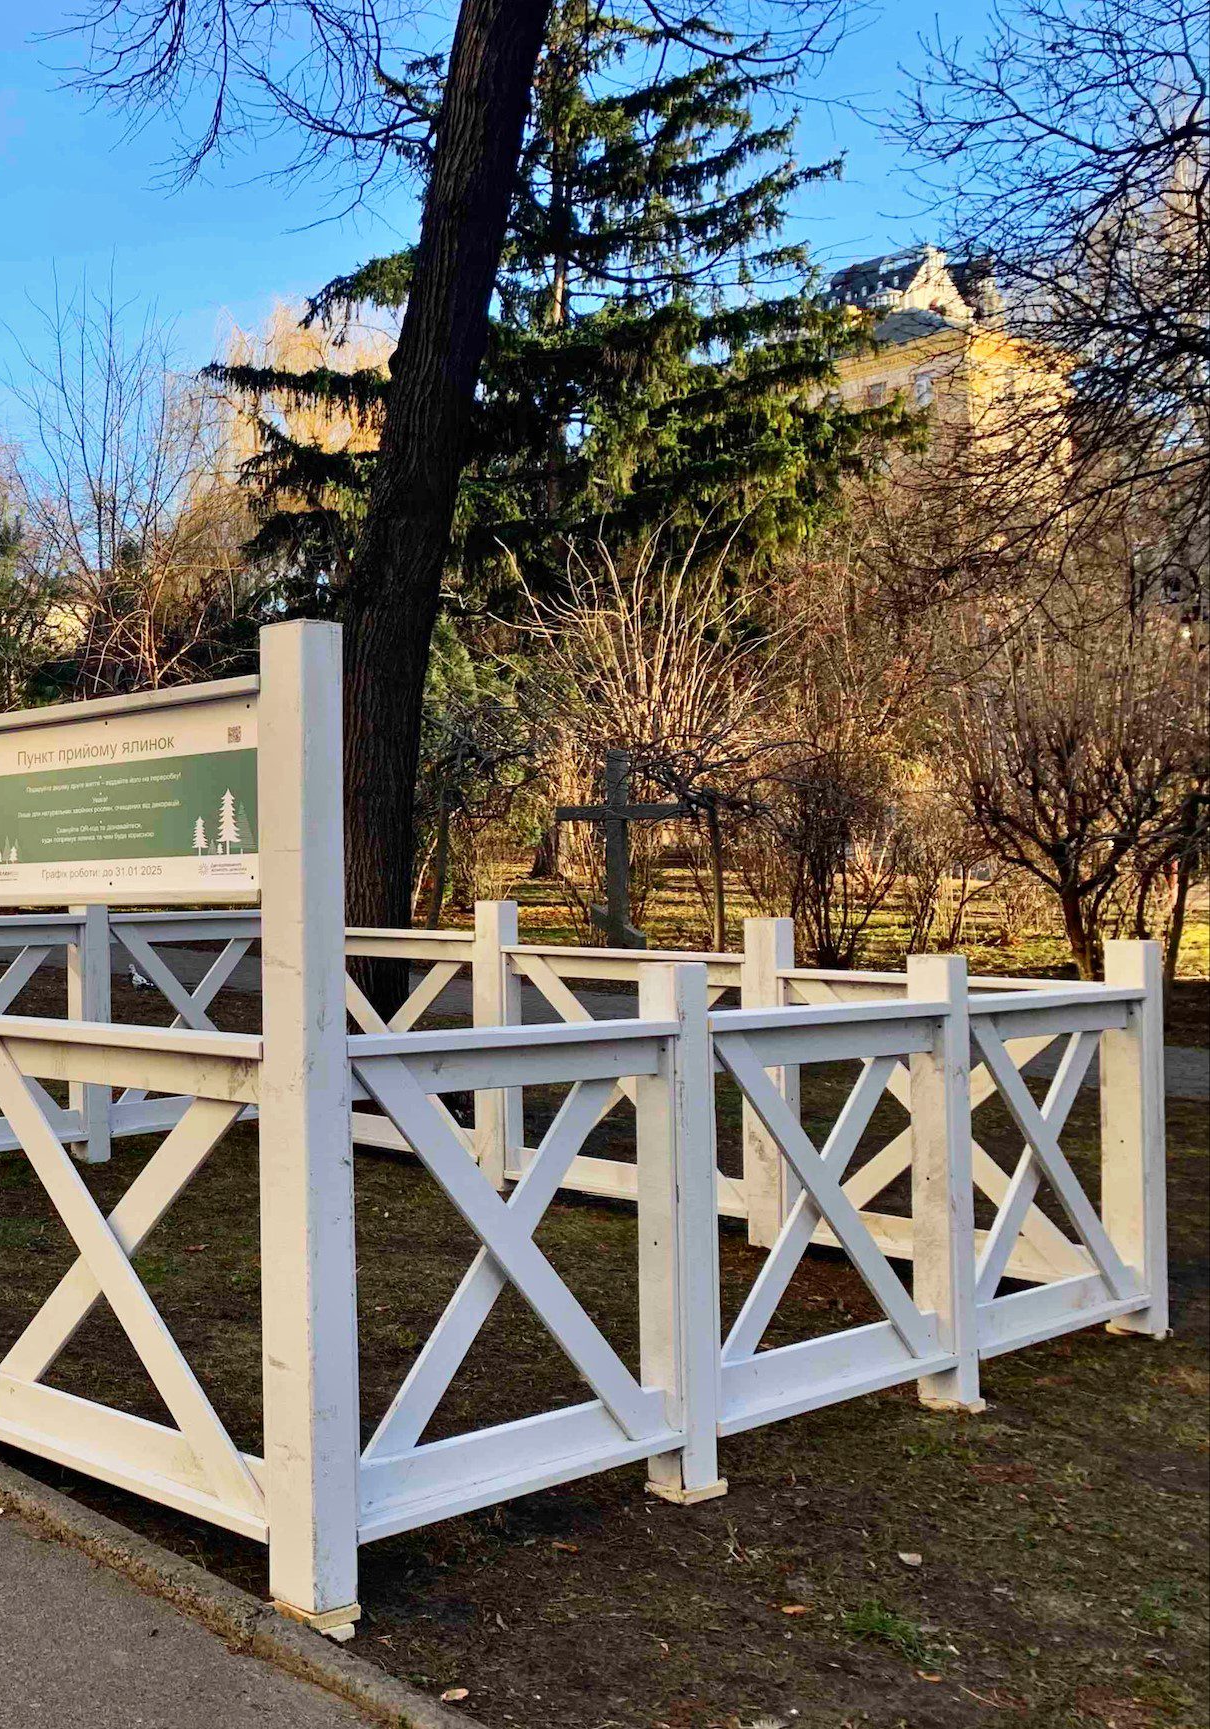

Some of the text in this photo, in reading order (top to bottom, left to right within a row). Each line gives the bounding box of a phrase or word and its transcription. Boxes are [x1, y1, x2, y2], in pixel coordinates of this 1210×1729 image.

[17, 737, 175, 768] Пункт прийому ялинок
[42, 869, 67, 881] Графік
[102, 868, 113, 878] до
